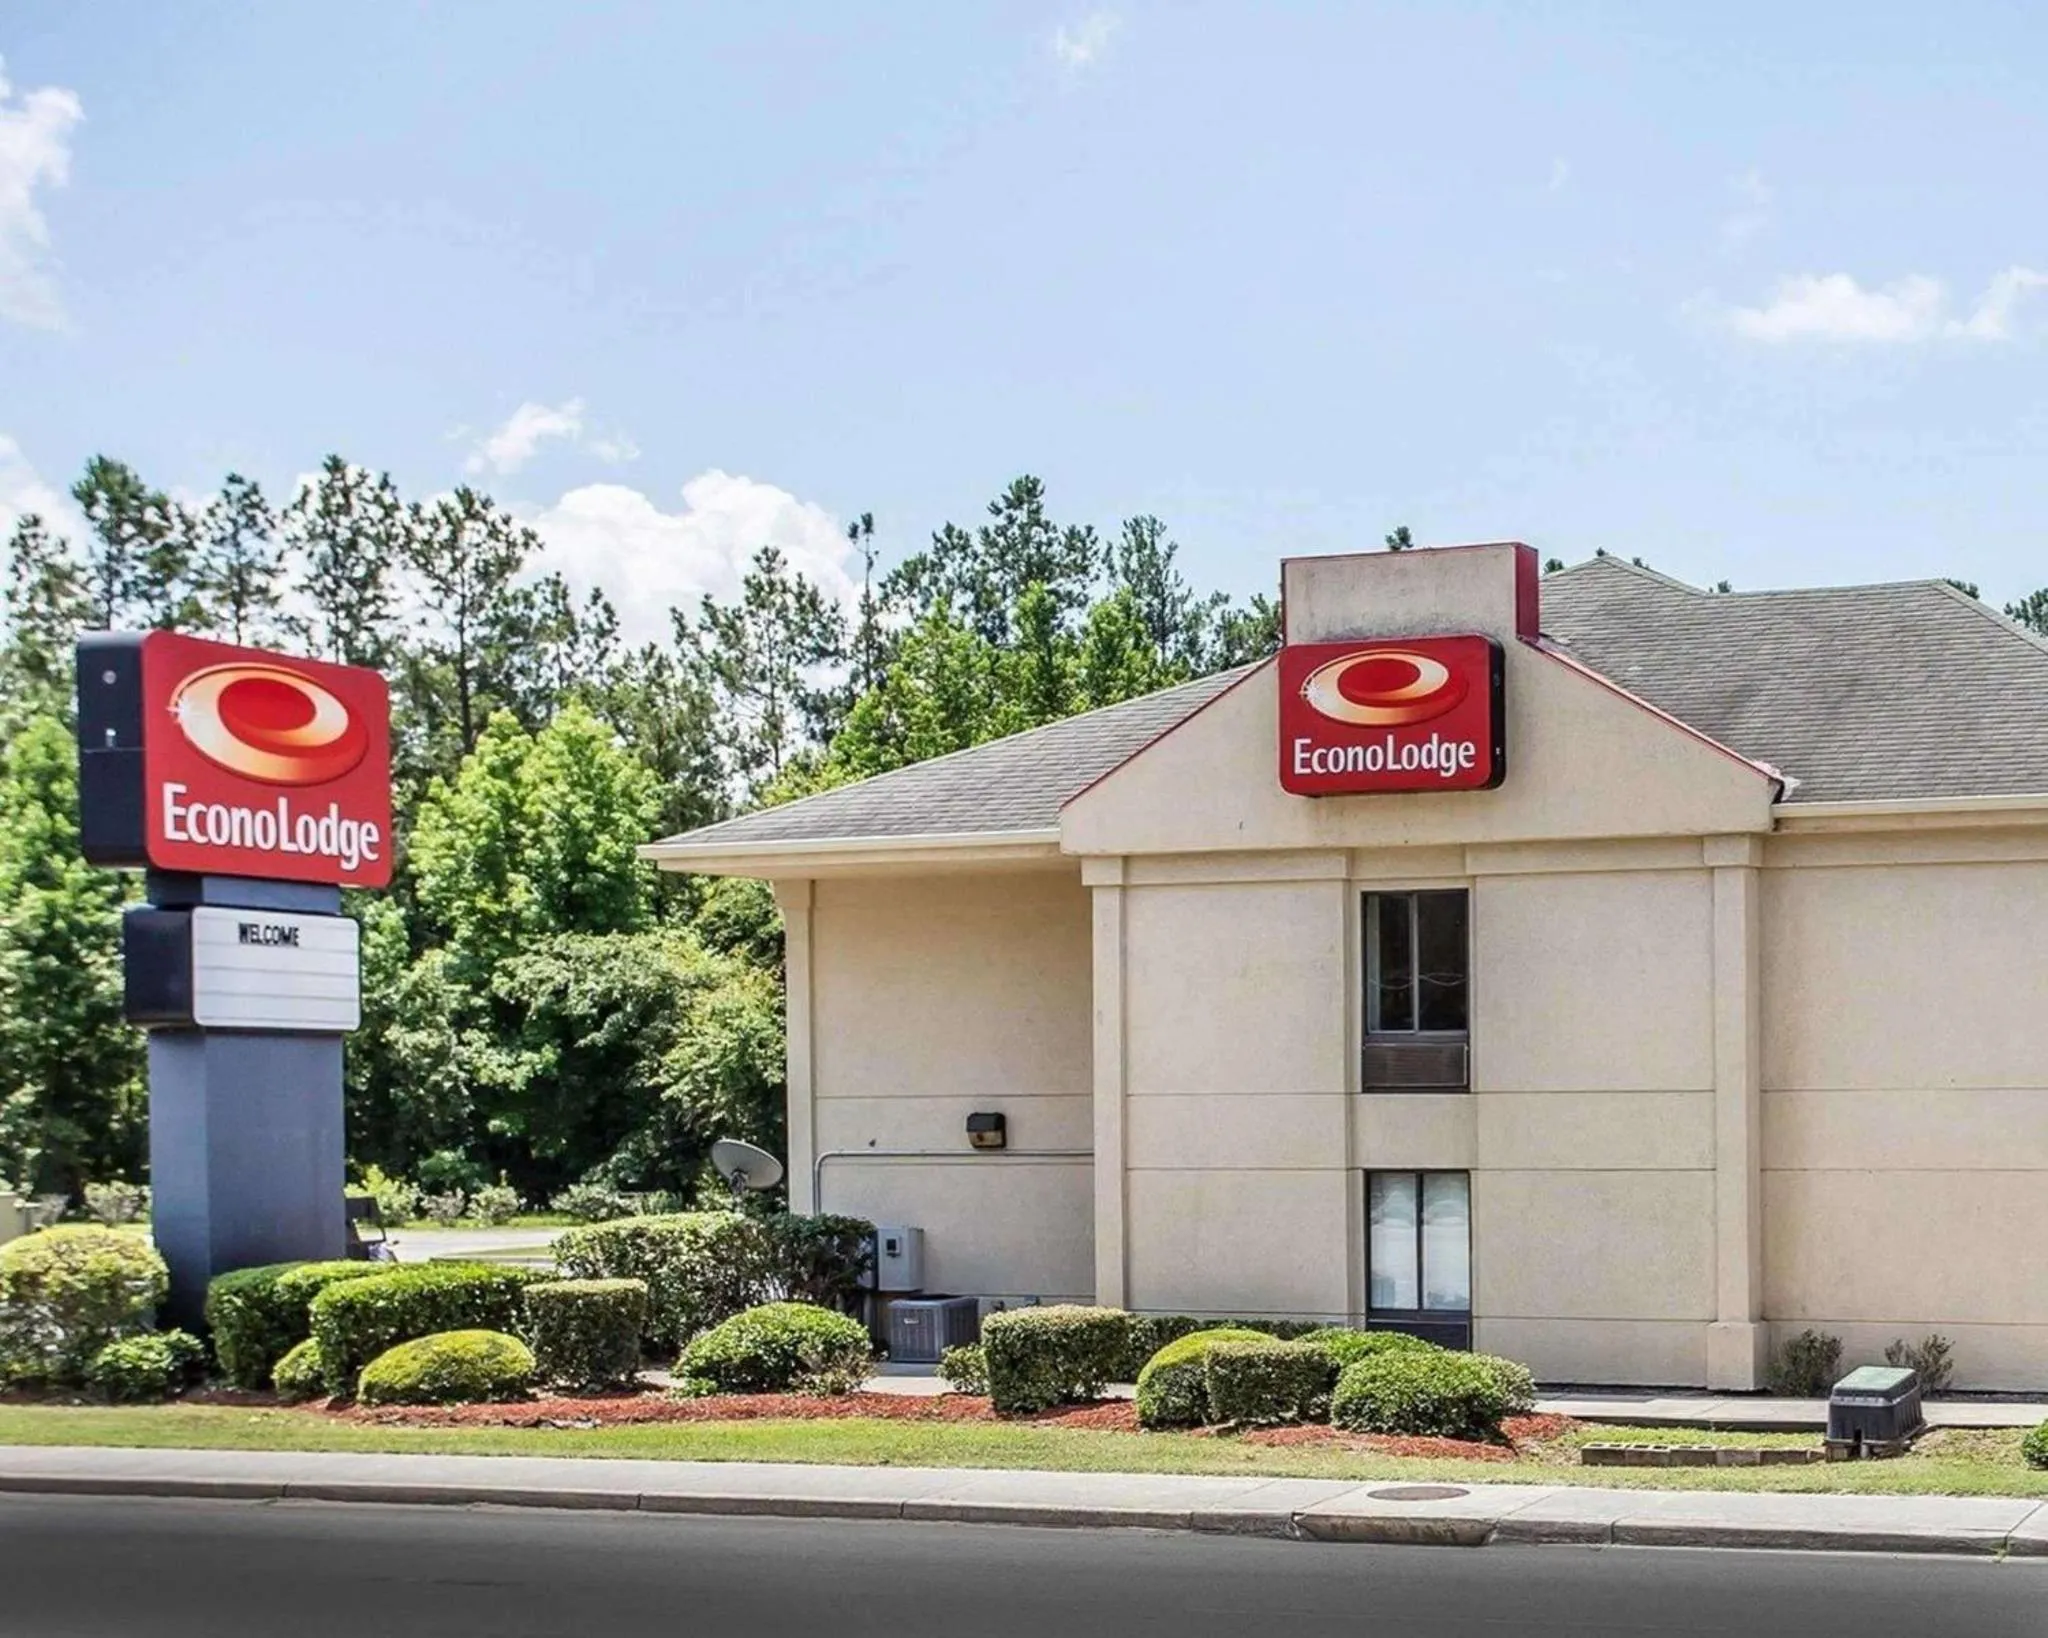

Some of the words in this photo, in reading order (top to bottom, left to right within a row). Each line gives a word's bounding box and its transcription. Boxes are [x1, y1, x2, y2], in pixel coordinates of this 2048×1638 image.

[1294, 732, 1476, 777] EconoLodge
[162, 782, 380, 870] EconoLodge
[238, 923, 300, 947] WELCOME
